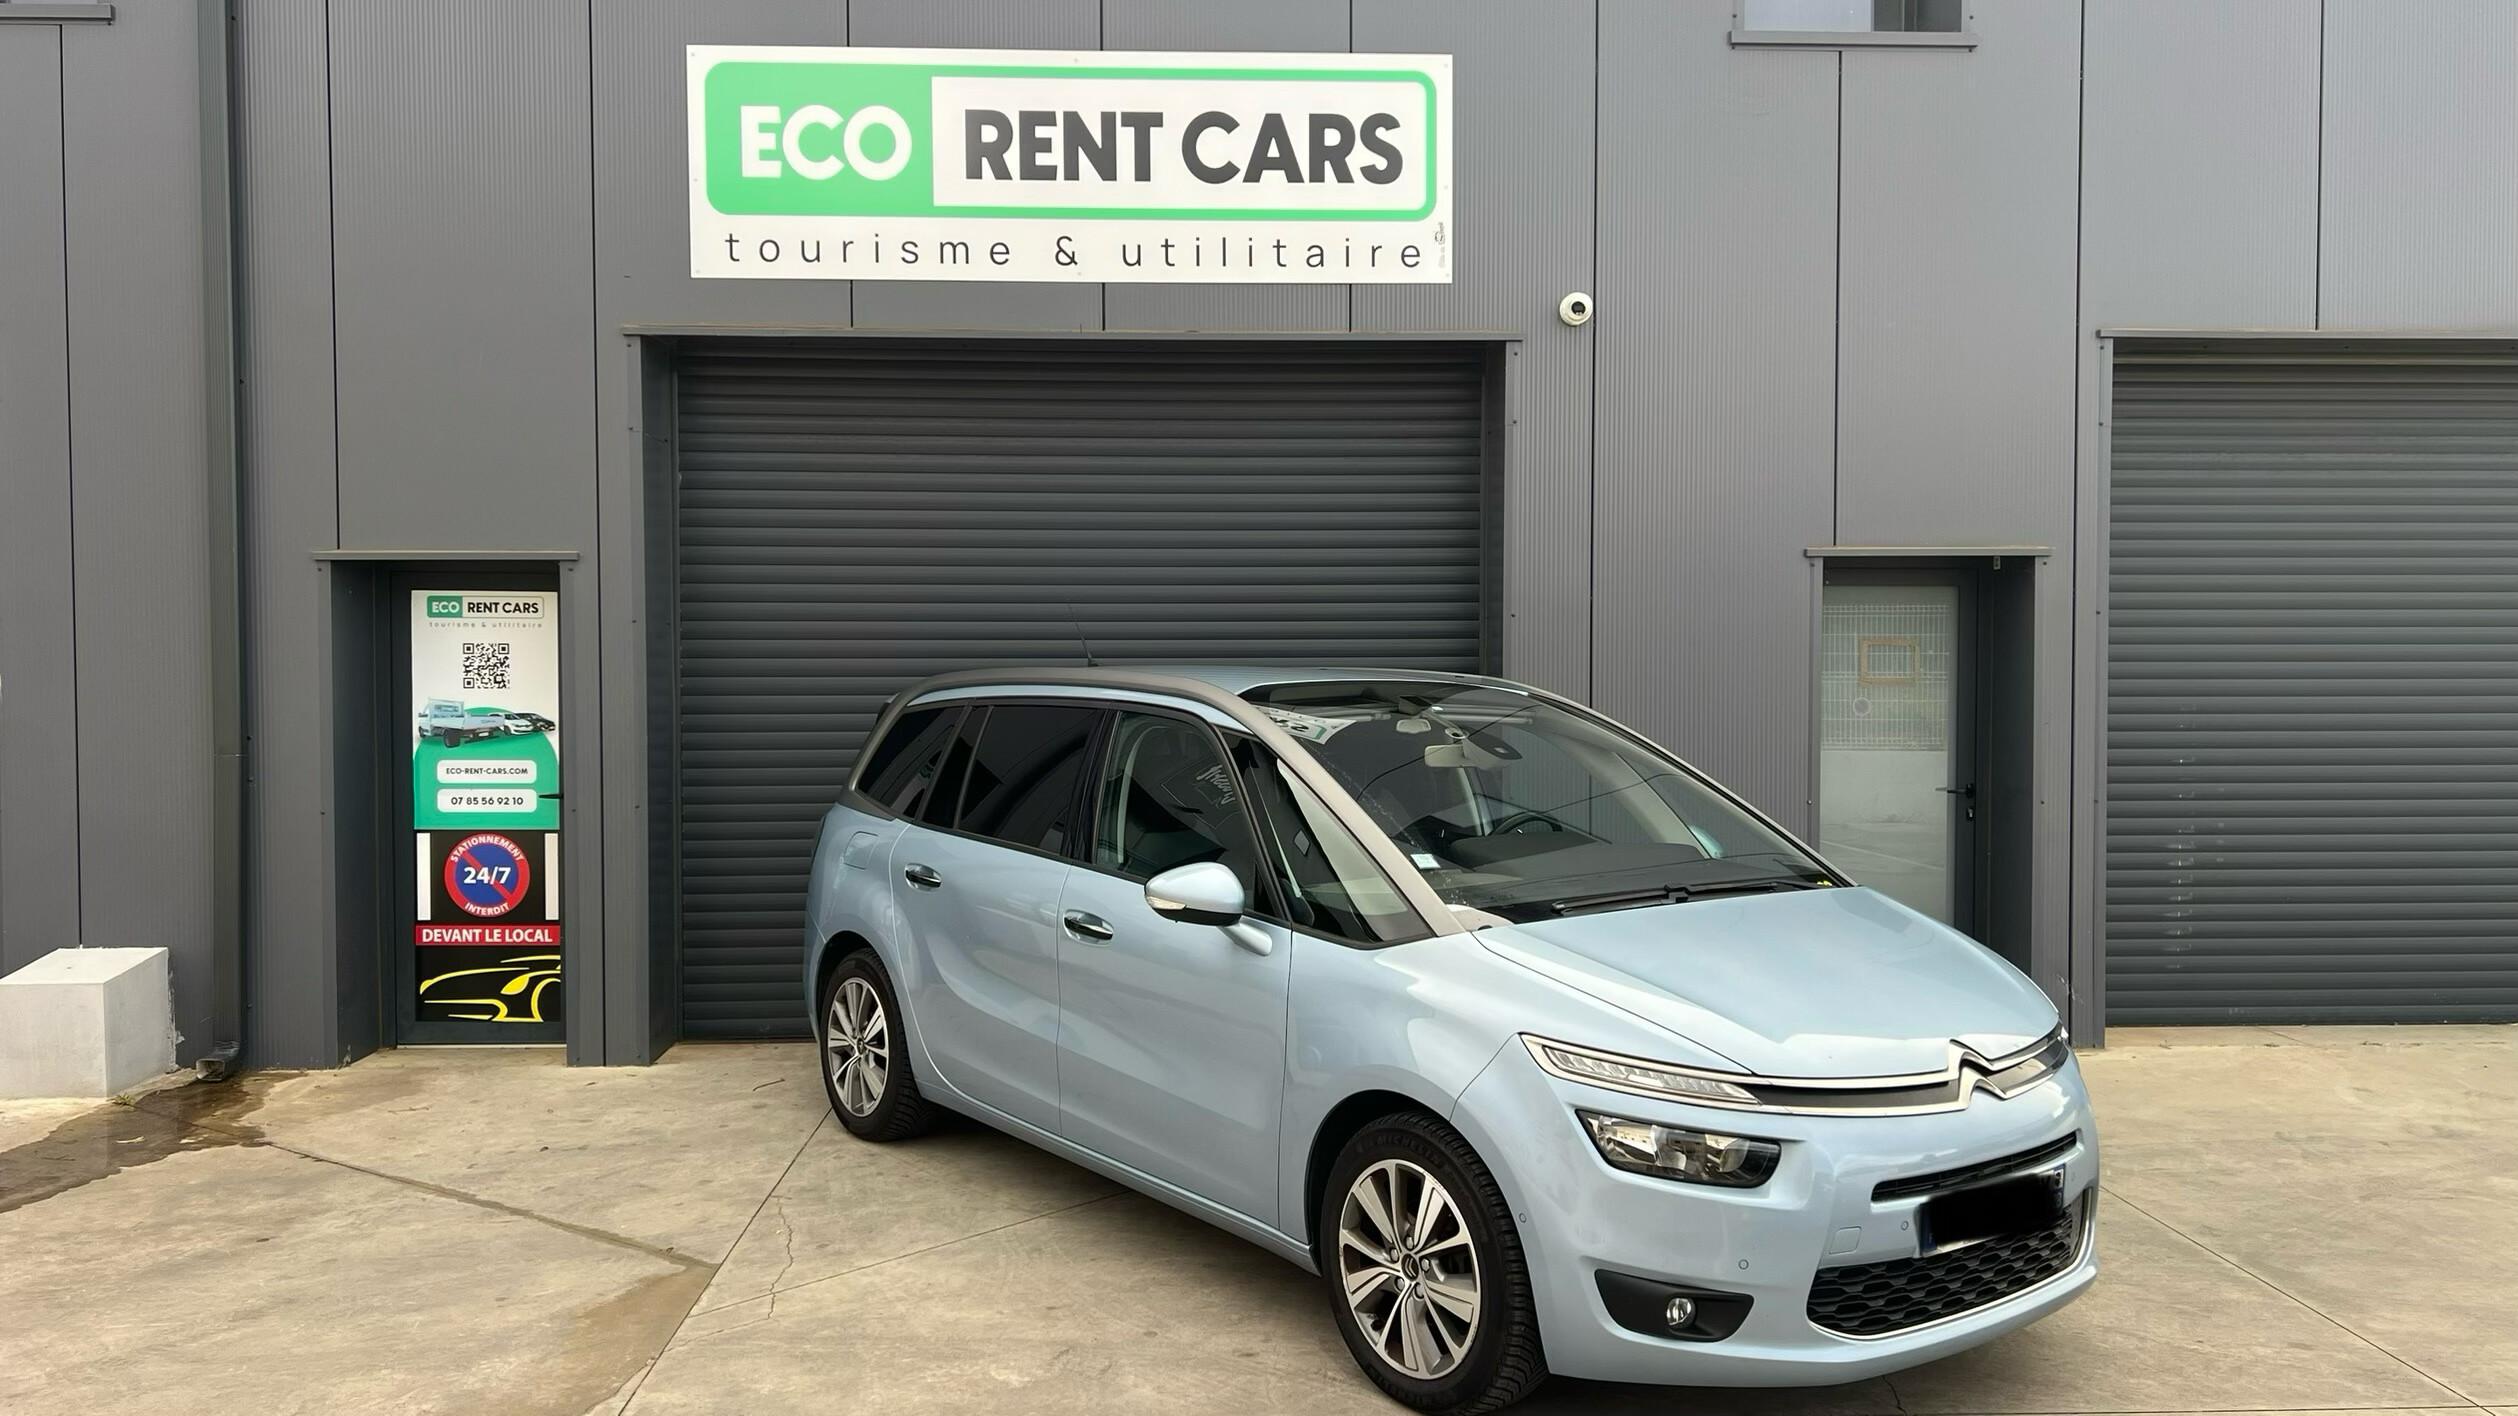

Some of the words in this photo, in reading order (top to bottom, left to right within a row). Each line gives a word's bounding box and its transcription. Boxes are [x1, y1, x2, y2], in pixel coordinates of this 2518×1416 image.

[739, 104, 913, 181] ECO
[964, 109, 1164, 182] RENT
[1181, 111, 1403, 184] CARS
[725, 233, 1011, 266] tourisme
[1054, 236, 1078, 267] &
[1122, 237, 1421, 268] utilitaire
[431, 602, 460, 614] ECO
[467, 602, 500, 614] RENT
[502, 602, 539, 614] CARS
[446, 767, 528, 775] ECO-RENT-CARS.COM
[450, 796, 463, 805] 07
[466, 796, 479, 806] 85
[481, 796, 494, 806] 56
[496, 796, 510, 806] 92
[512, 796, 524, 806] 10
[450, 835, 525, 863] STATIONNEMENT
[463, 866, 511, 885] 24/7
[464, 902, 510, 916] INTERDIT
[422, 928, 482, 943] DEVANT
[485, 928, 501, 943] LE
[505, 928, 553, 943] LOCAL
